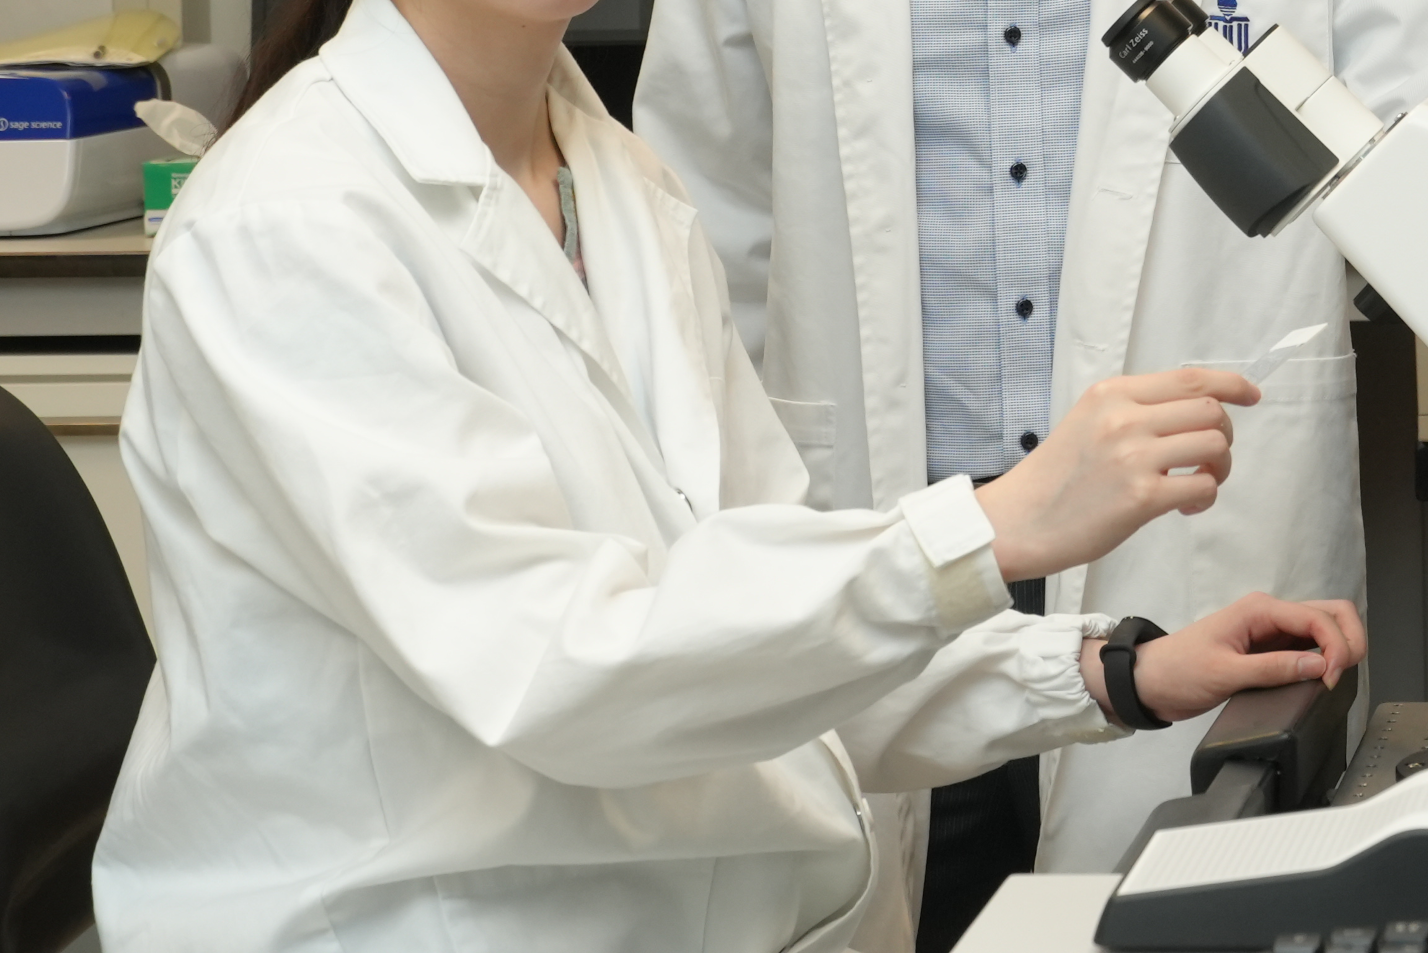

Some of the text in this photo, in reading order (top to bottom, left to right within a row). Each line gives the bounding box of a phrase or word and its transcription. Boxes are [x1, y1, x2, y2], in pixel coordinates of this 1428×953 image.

[1118, 44, 1132, 59] Carl
[1129, 28, 1149, 47] Zeiss
[10, 120, 63, 131] sage science
